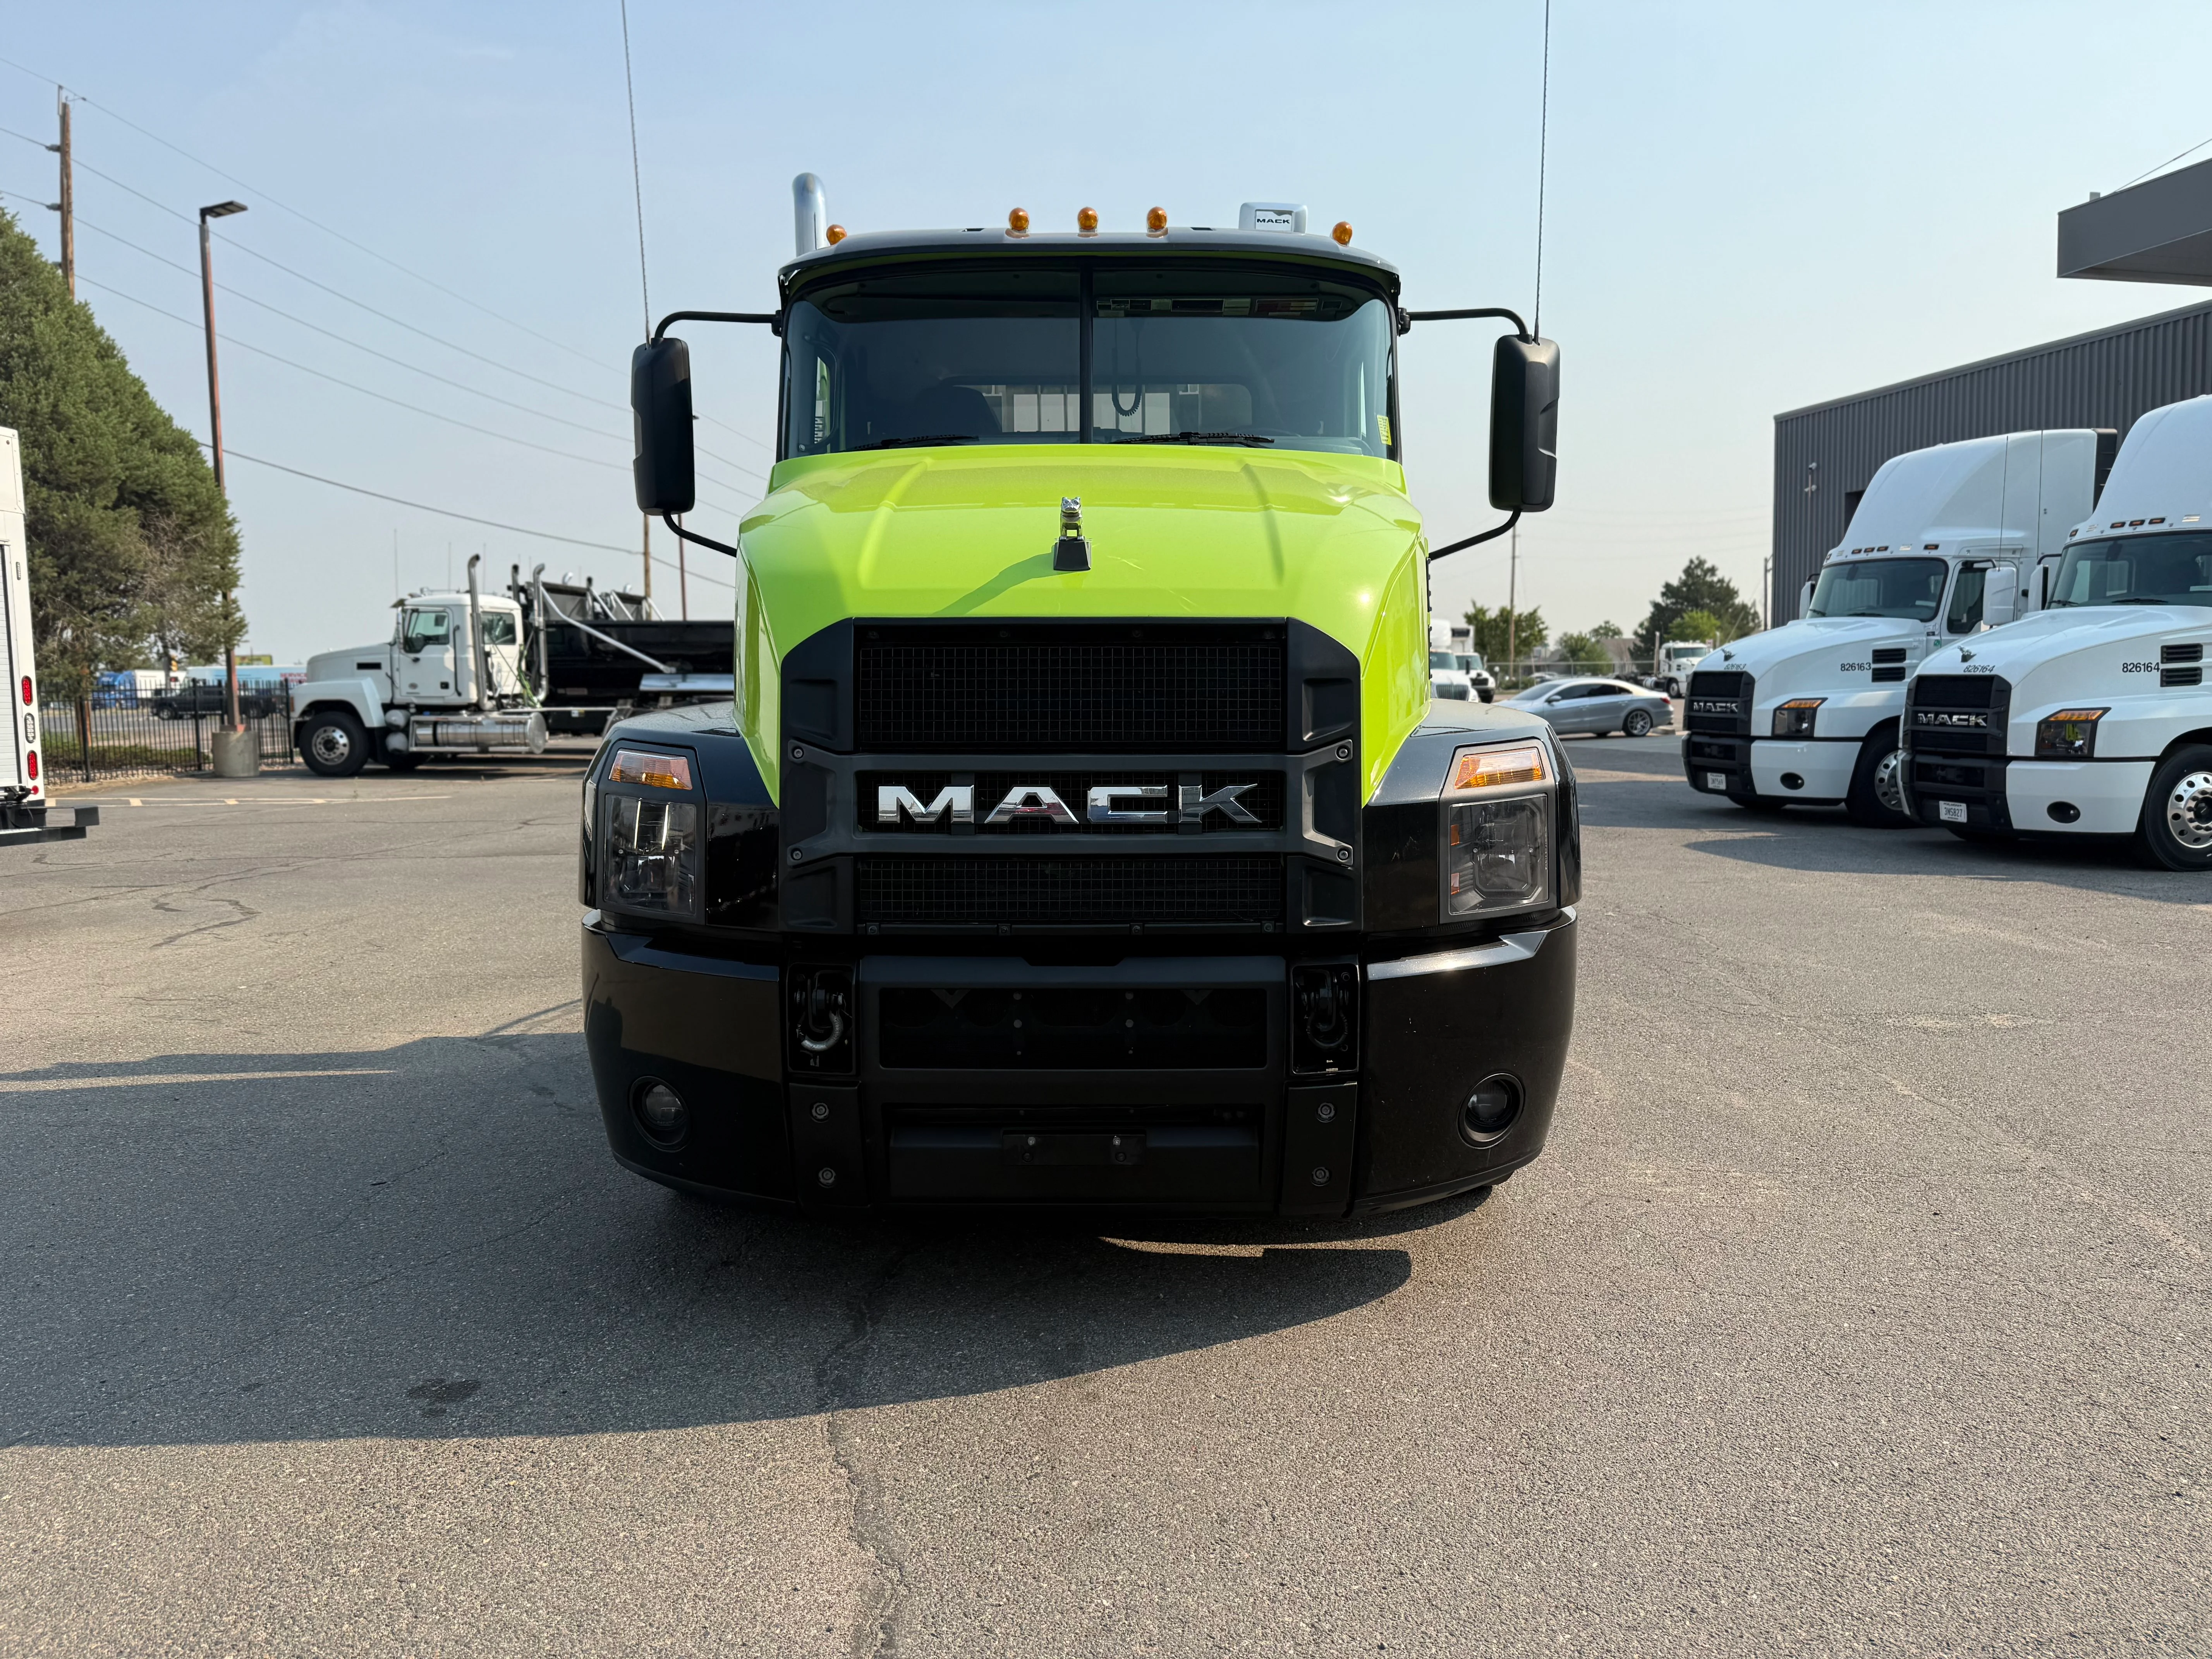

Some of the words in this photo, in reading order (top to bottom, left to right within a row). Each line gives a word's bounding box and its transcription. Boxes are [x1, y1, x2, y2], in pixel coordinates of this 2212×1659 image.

[1841, 662, 1871, 671] 826163
[2122, 662, 2160, 673] 826164
[1694, 702, 1738, 712] MACK
[1918, 713, 1987, 727] MACK
[877, 783, 1262, 824] MACK
[1944, 807, 1962, 817] 3NS827
